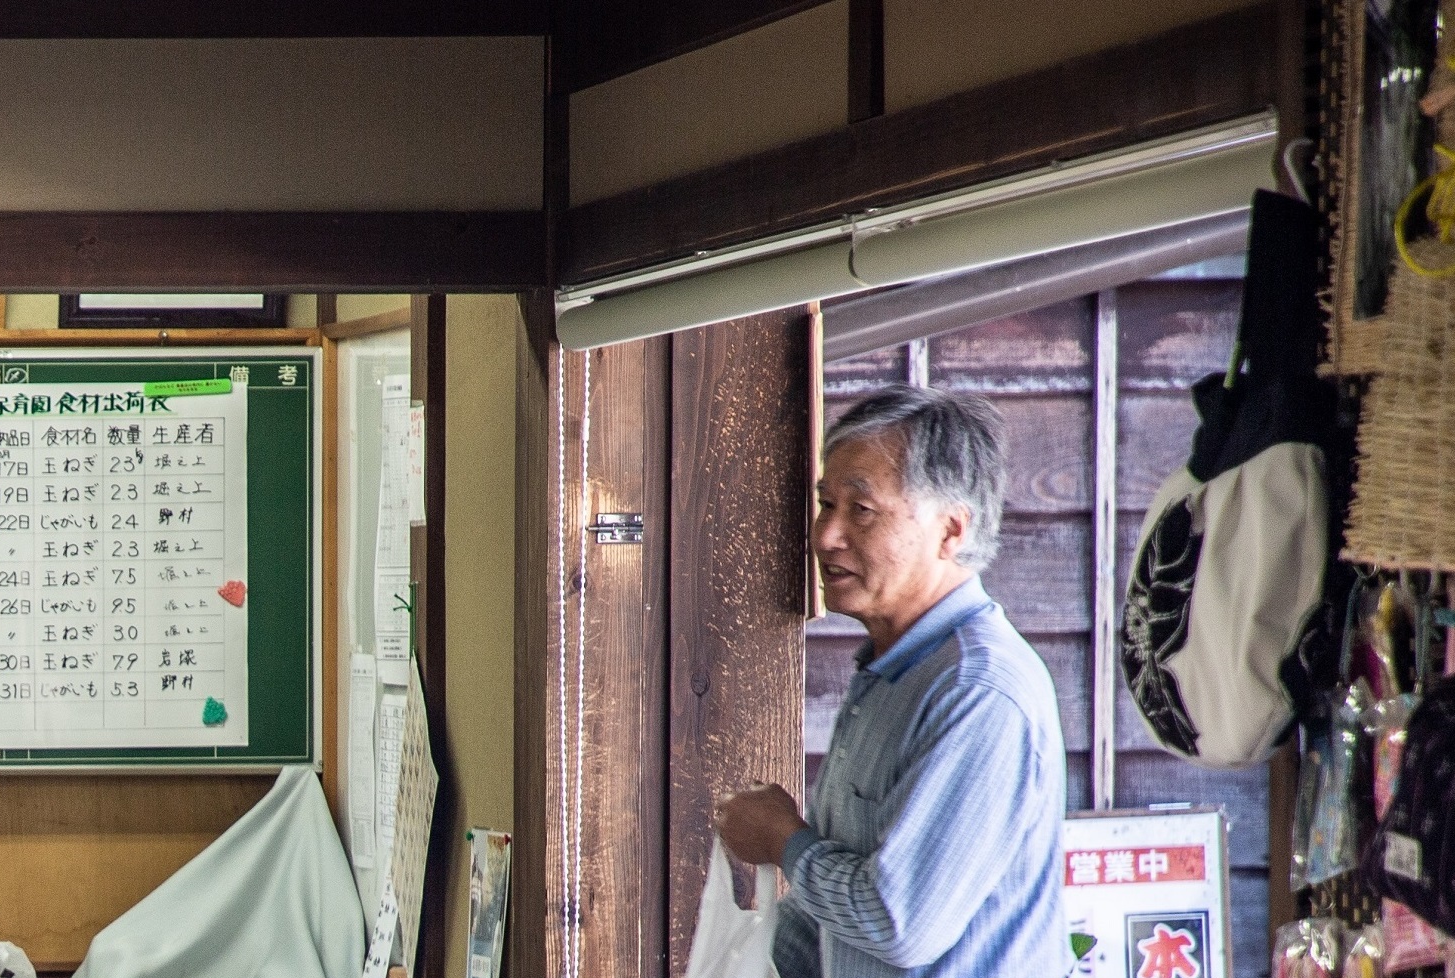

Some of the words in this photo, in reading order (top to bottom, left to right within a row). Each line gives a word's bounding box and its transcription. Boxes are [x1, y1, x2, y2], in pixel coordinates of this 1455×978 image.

[41, 426, 97, 447] 食材名
[107, 425, 142, 446] 数量
[153, 423, 215, 446] 生産者
[42, 454, 98, 474] 玉ねぎ
[42, 482, 99, 503] 玉ねぎ
[41, 514, 98, 530] じゃがいも
[42, 539, 98, 557] 玉ねぎ
[42, 566, 98, 587] 玉ねぎ
[0, 598, 31, 614] 26日
[41, 598, 97, 613] じゃがいも
[43, 624, 97, 641] 玉ねぎ
[43, 652, 98, 670] 玉ねぎ
[0, 683, 31, 699] 31日
[1070, 849, 1168, 885] 営業中
